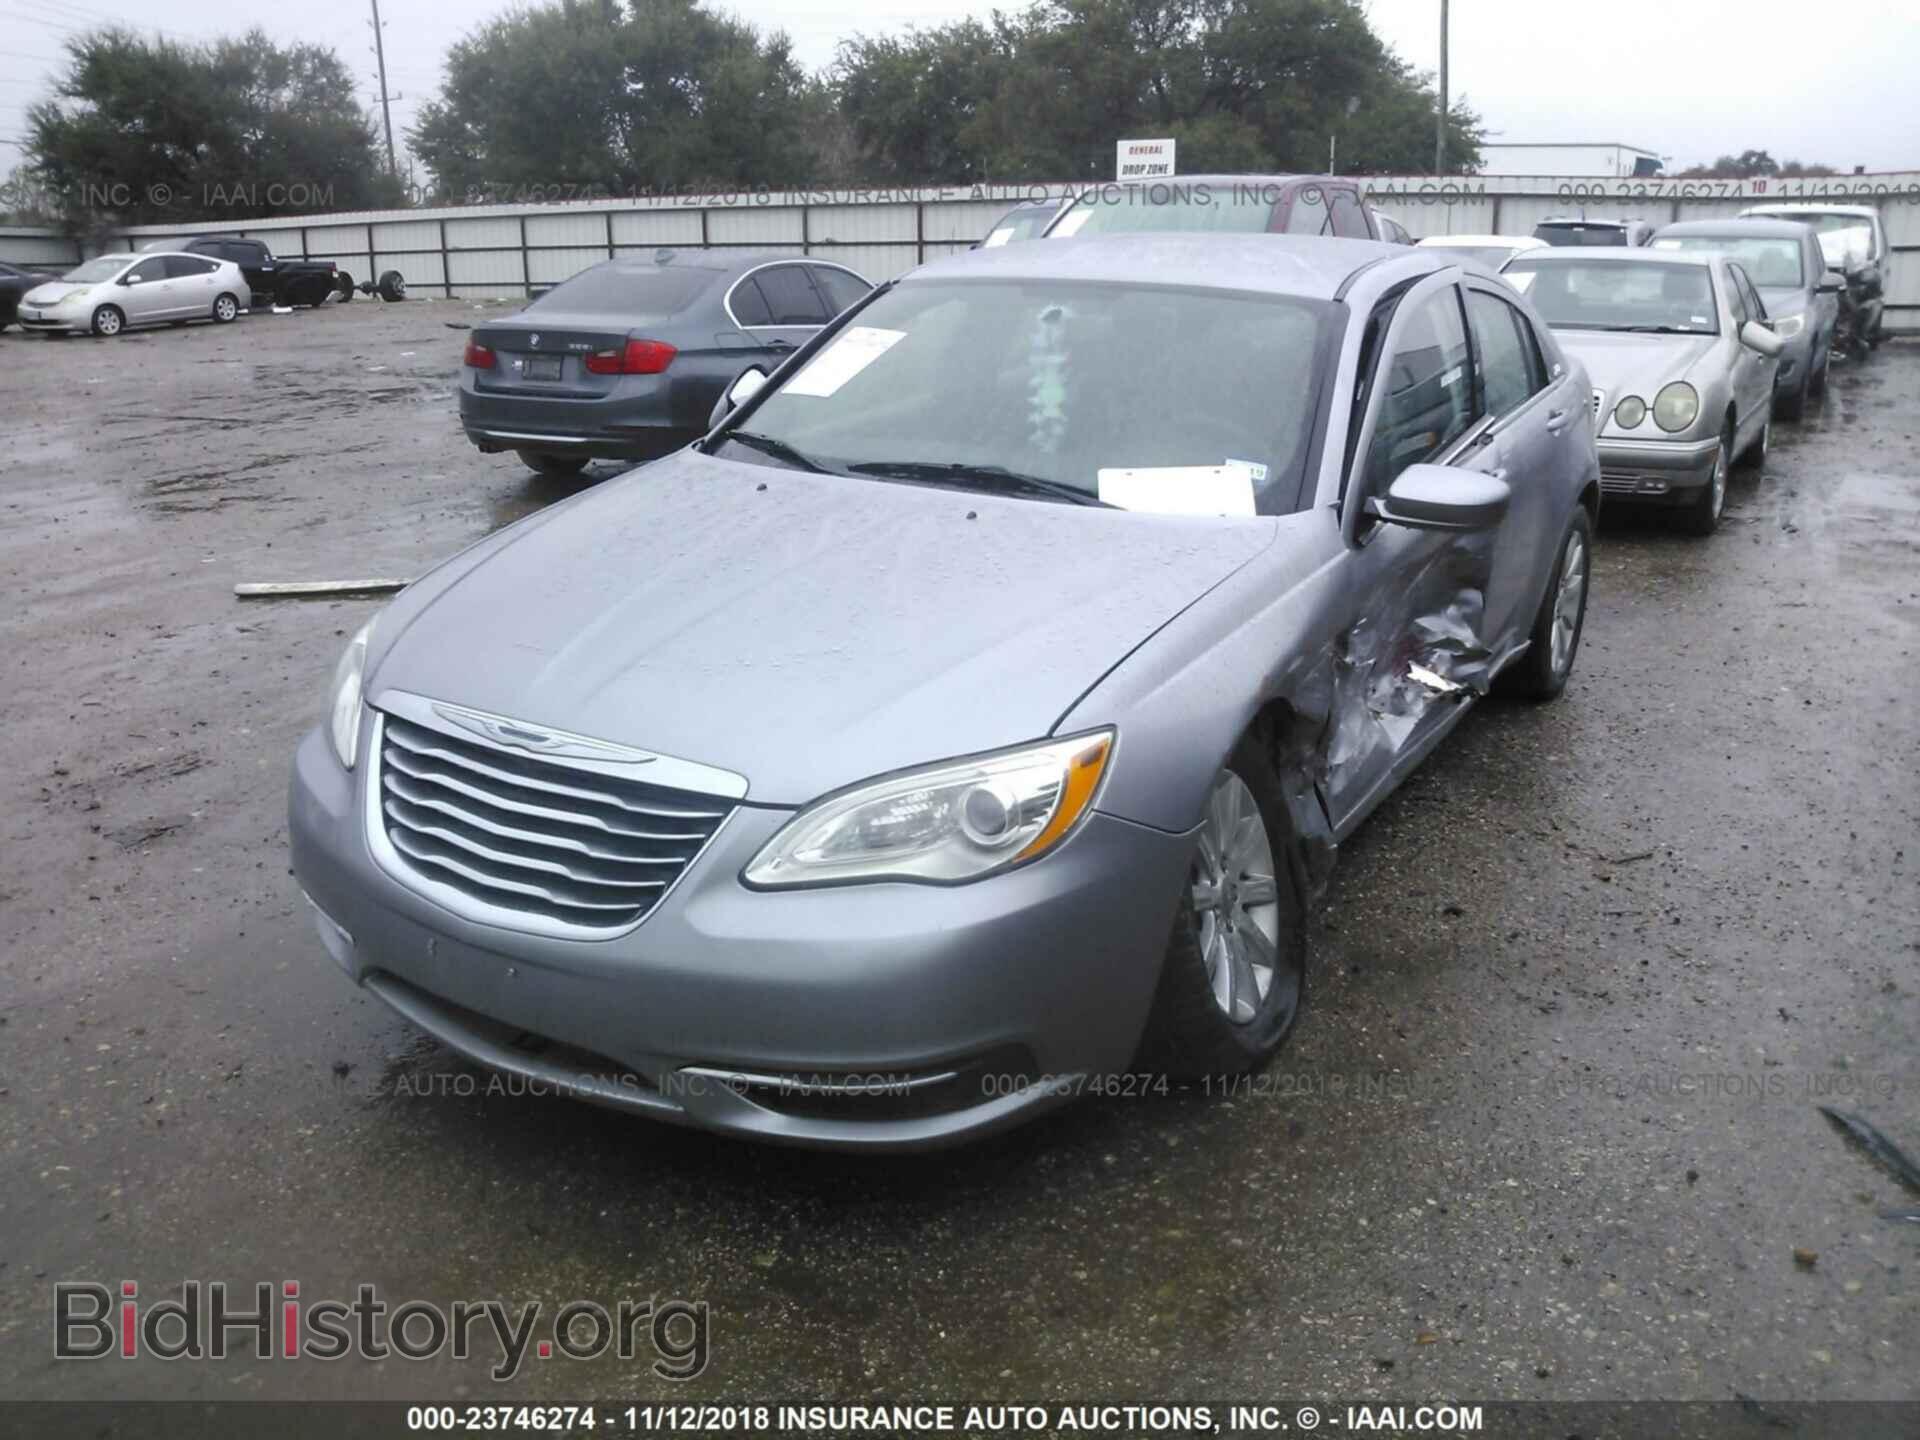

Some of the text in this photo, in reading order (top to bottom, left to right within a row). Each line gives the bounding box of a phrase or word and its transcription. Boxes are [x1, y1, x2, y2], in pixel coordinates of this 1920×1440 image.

[1128, 145, 1163, 155] GENERAL
[1122, 163, 1168, 175] DROP ZONE
[1752, 180, 1767, 193] 10
